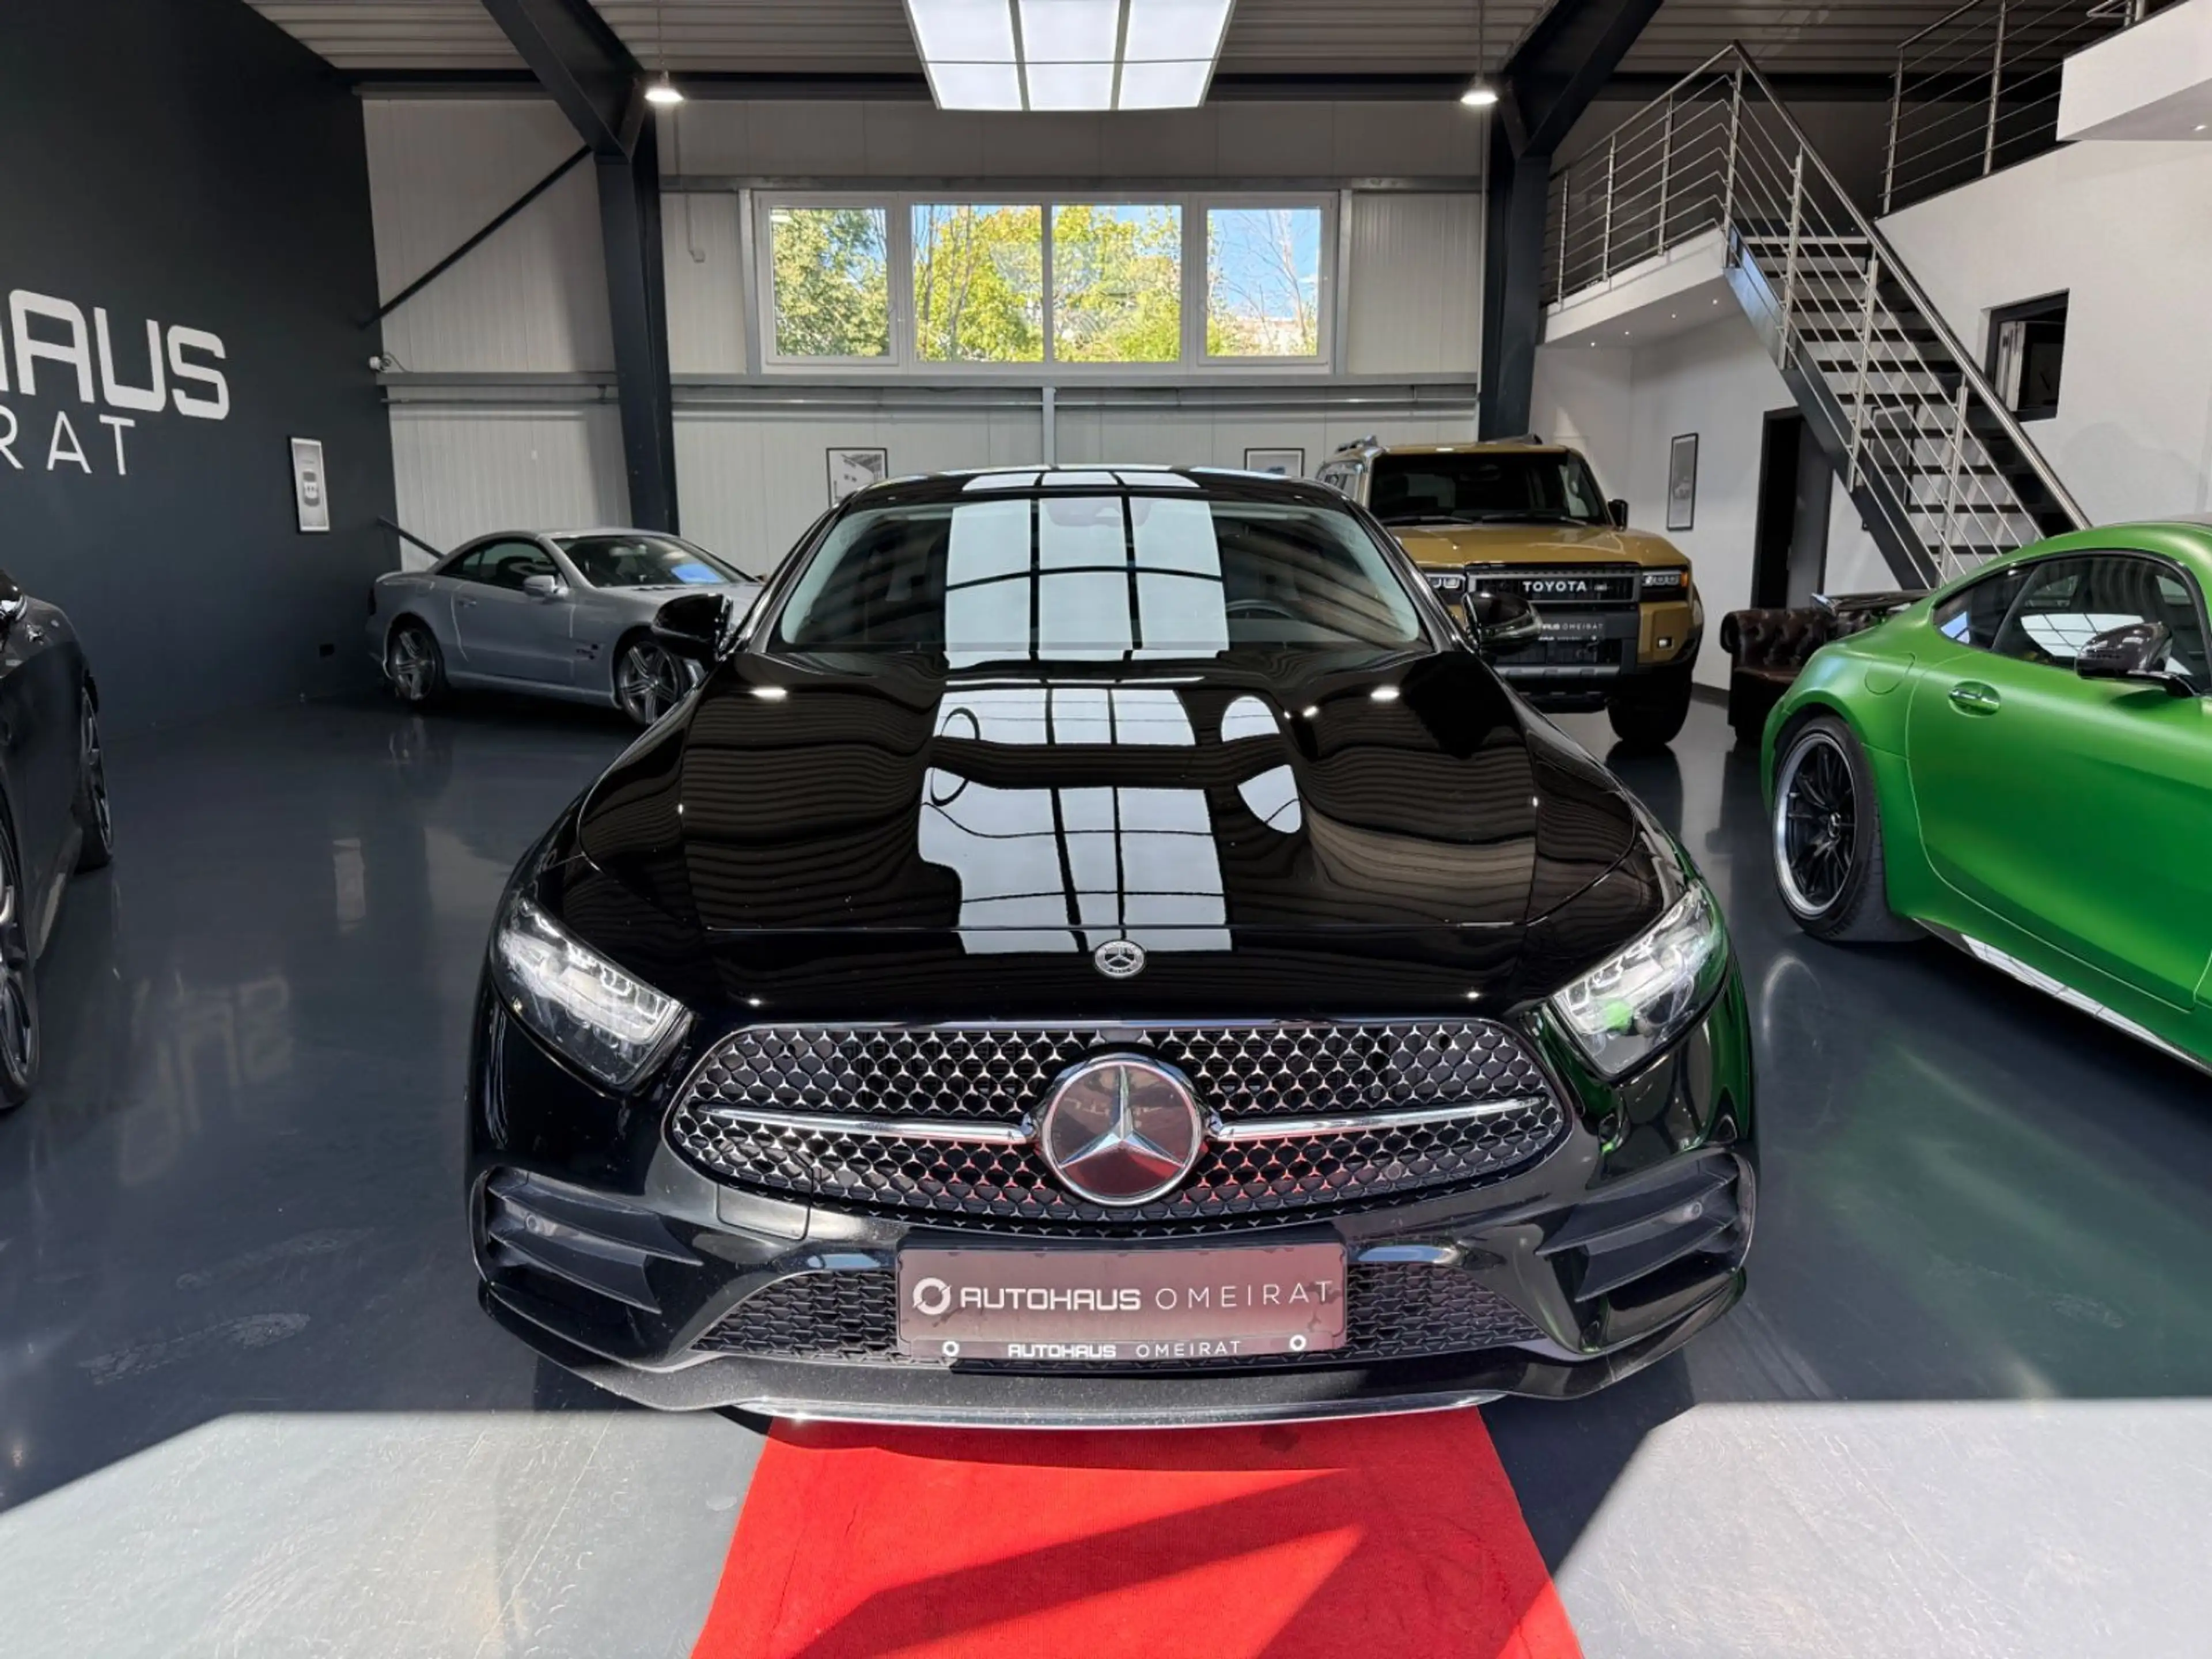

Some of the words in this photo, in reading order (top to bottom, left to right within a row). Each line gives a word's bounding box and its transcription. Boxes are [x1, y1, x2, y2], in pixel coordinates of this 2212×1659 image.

[1522, 580, 1587, 592] TOYOTA
[960, 1286, 1141, 1311] AUTOHAUS
[1155, 1280, 1333, 1310] OMEIRAT
[1007, 1343, 1117, 1358] AUTOHAUS
[1135, 1340, 1242, 1358] OMEIRAT
